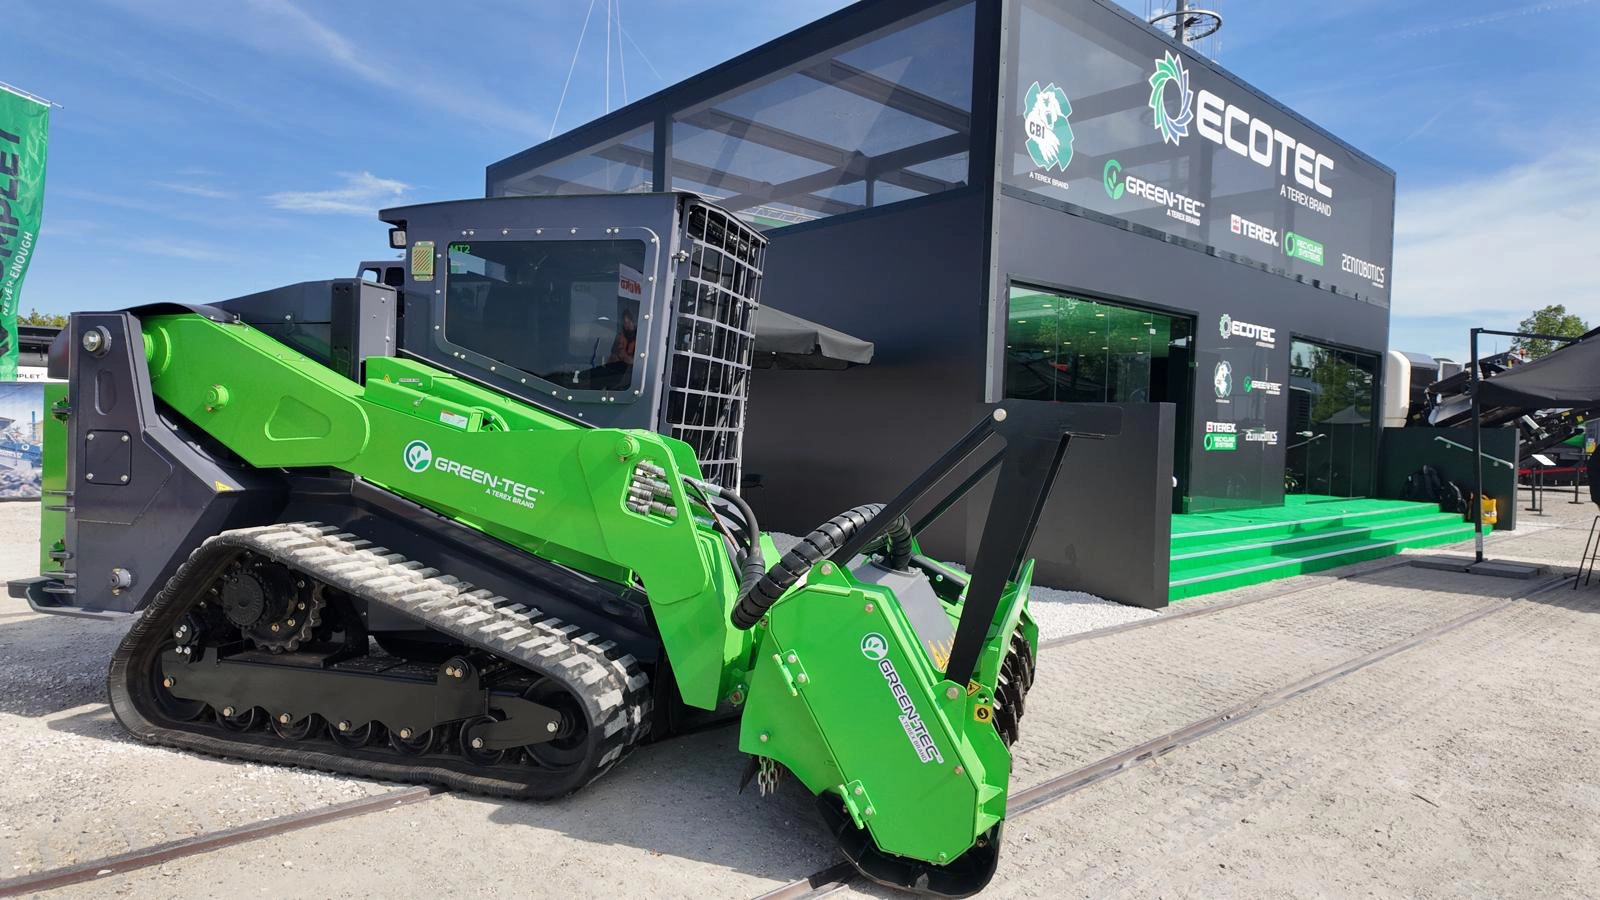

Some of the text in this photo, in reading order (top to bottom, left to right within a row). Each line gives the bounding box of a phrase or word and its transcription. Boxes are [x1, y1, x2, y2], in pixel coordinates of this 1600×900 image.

[1029, 123, 1045, 139] CBI
[1196, 89, 1334, 198] ECOTEC
[1034, 173, 1052, 184] TEREX
[1052, 179, 1069, 190] BRAND
[1280, 185, 1332, 217] A TEREX BRAND
[1241, 219, 1278, 247] TEREX
[3, 231, 33, 317] NEVER ENOUGH
[1231, 320, 1276, 343] ECOTEC
[1213, 422, 1237, 433] TEREX
[492, 490, 512, 502] TEREX
[512, 495, 535, 509] BRAND
[903, 721, 916, 740] TEREX
[913, 740, 928, 761] BRAND
